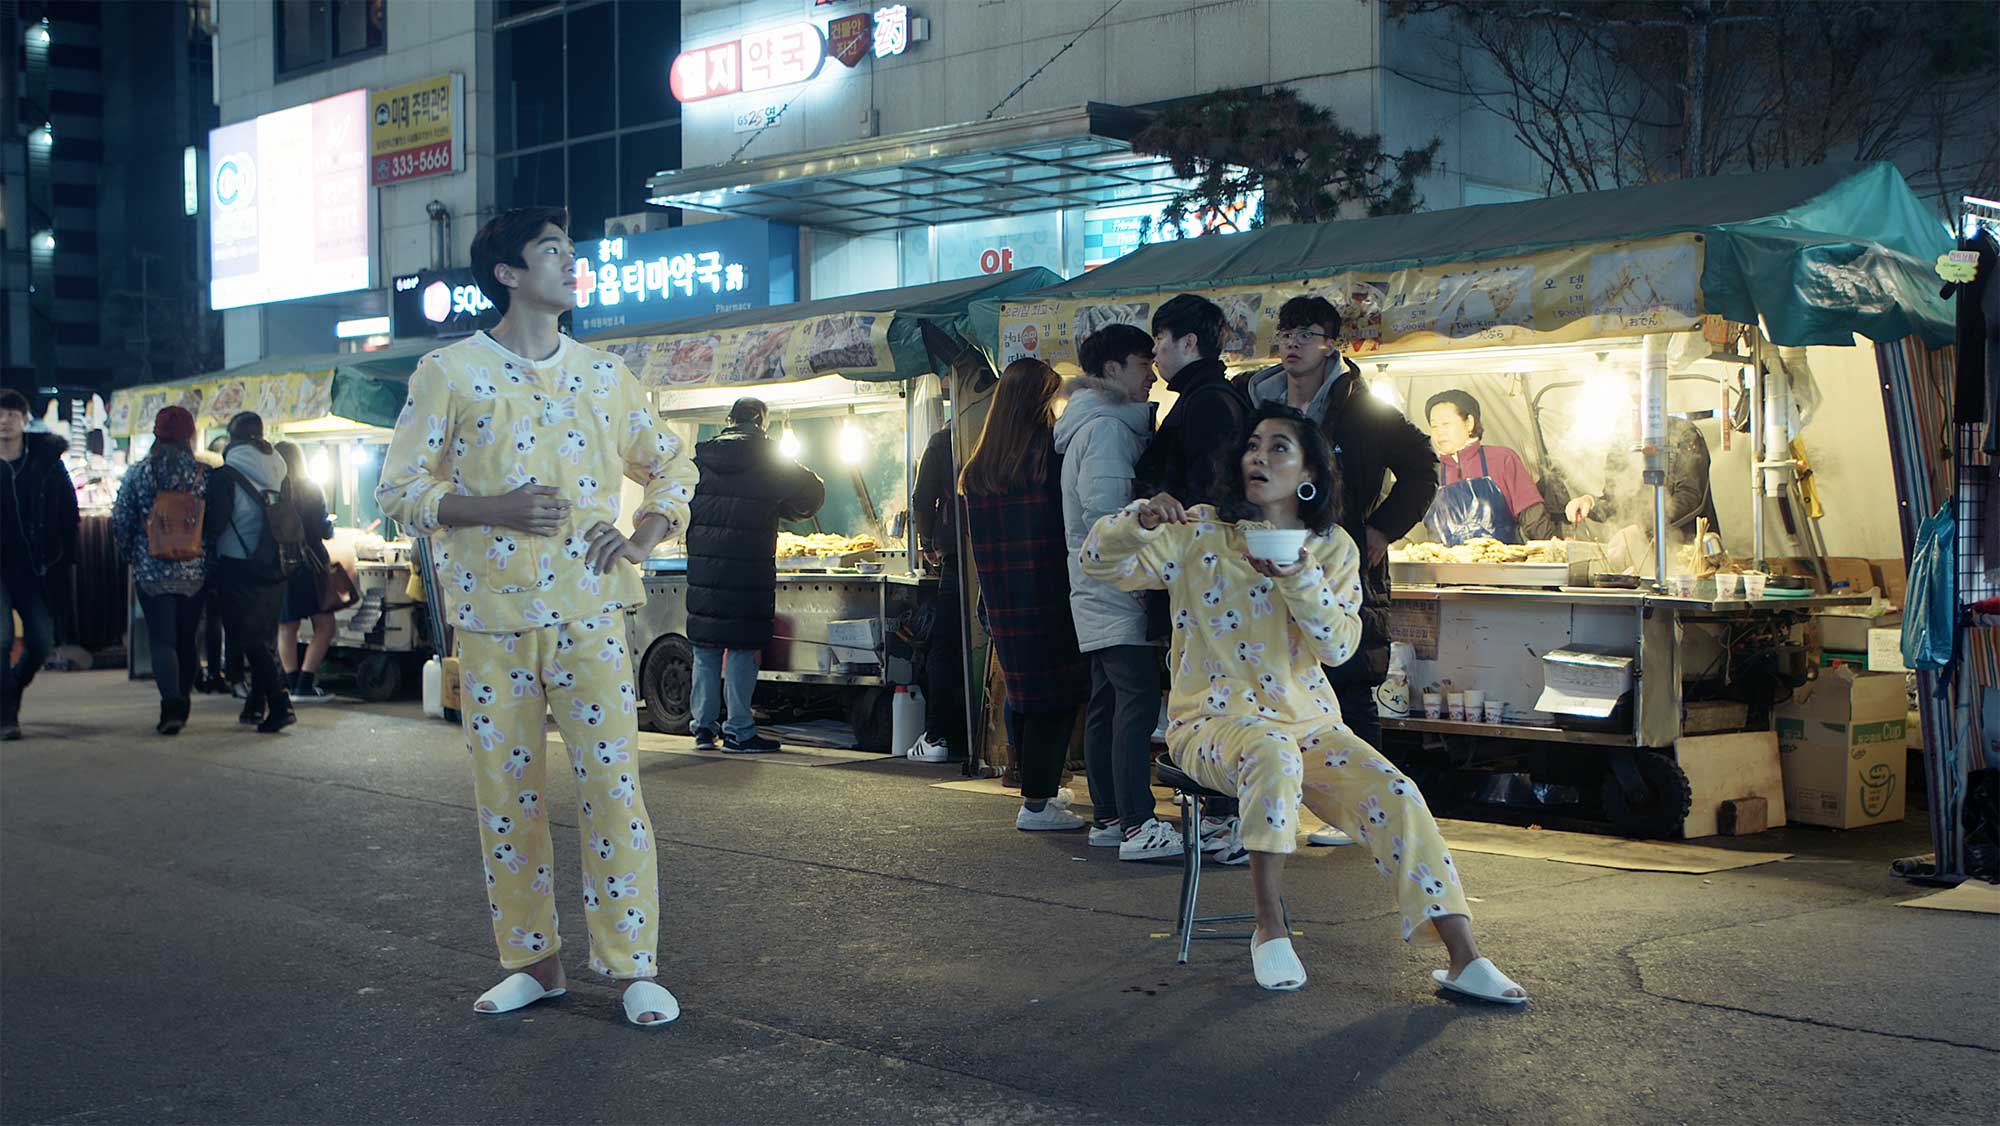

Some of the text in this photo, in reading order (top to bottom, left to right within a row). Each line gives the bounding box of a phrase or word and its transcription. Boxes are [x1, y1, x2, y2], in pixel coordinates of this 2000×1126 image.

[748, 31, 805, 80] 약국
[391, 85, 449, 130] 미래 주택관리
[392, 146, 450, 177] 333-5666
[453, 285, 493, 316] SQU
[714, 302, 752, 314] Pharmacy
[1629, 317, 1658, 328] おでん
